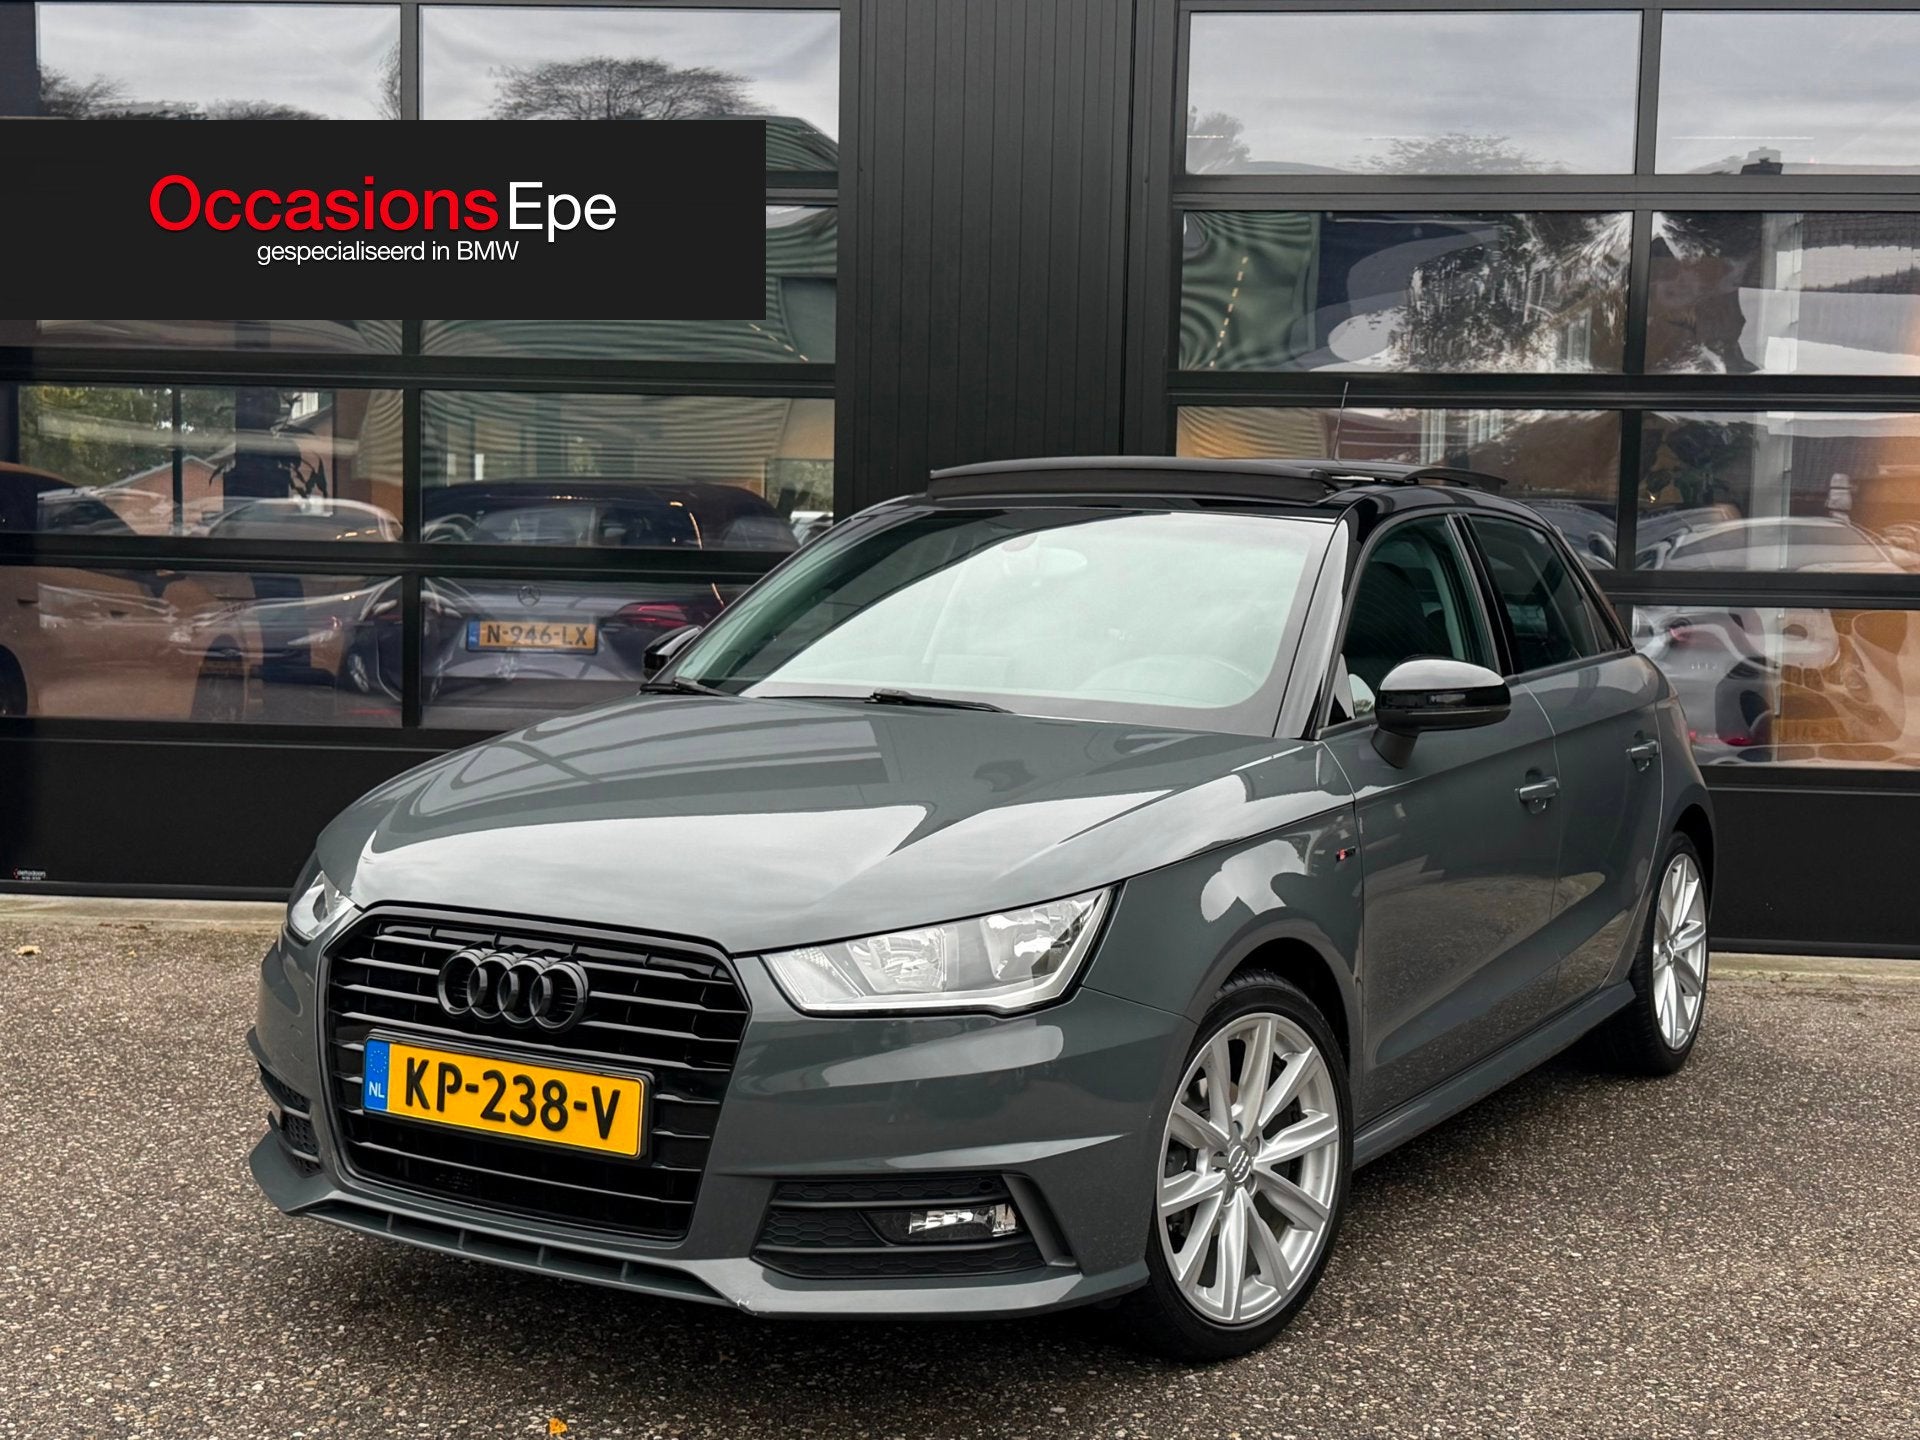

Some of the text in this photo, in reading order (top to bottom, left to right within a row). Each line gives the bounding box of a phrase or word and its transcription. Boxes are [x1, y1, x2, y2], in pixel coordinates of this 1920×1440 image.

[487, 624, 588, 646] N-946-LX
[369, 1082, 385, 1099] NL
[405, 1057, 621, 1140] KP-238-V
